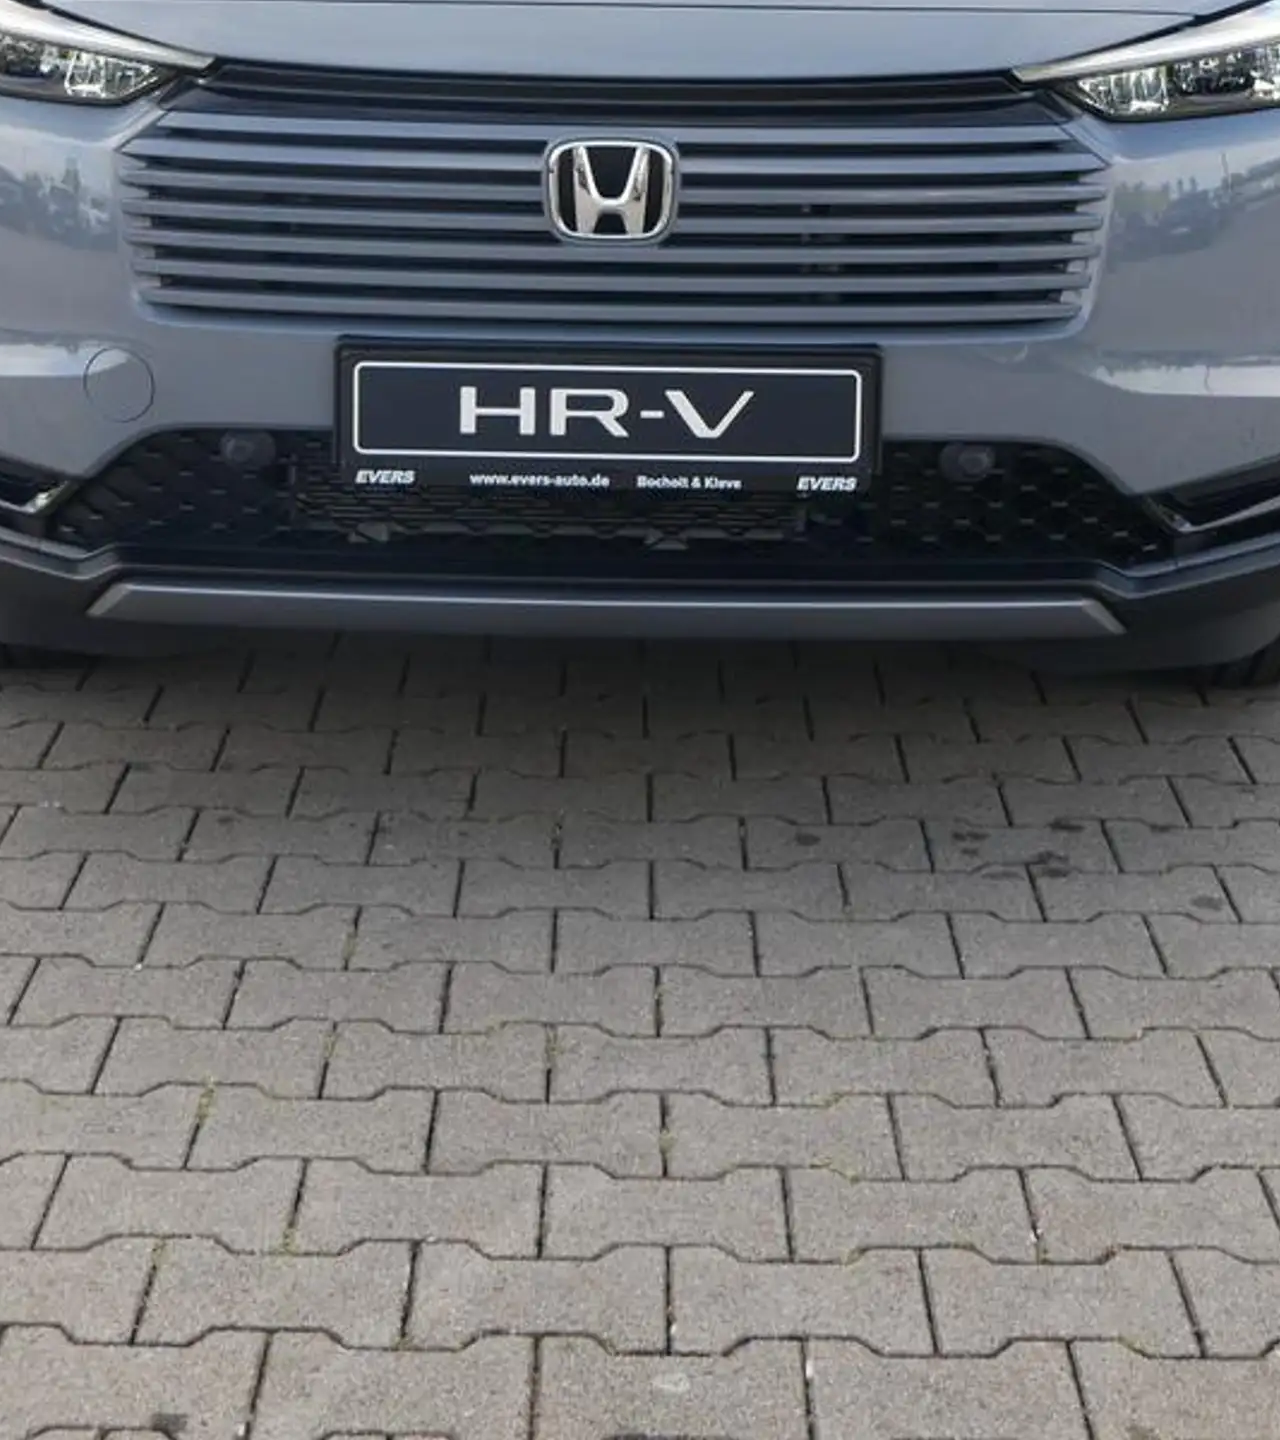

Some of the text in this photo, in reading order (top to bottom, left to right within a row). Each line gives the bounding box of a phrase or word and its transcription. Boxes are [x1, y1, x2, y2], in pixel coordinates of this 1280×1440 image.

[459, 386, 755, 438] HR-V
[356, 469, 415, 484] EVERS
[470, 472, 611, 489] www.evers-auto.de
[637, 475, 689, 490] Bocholt
[691, 477, 702, 490] &
[797, 476, 857, 492] EVERS
